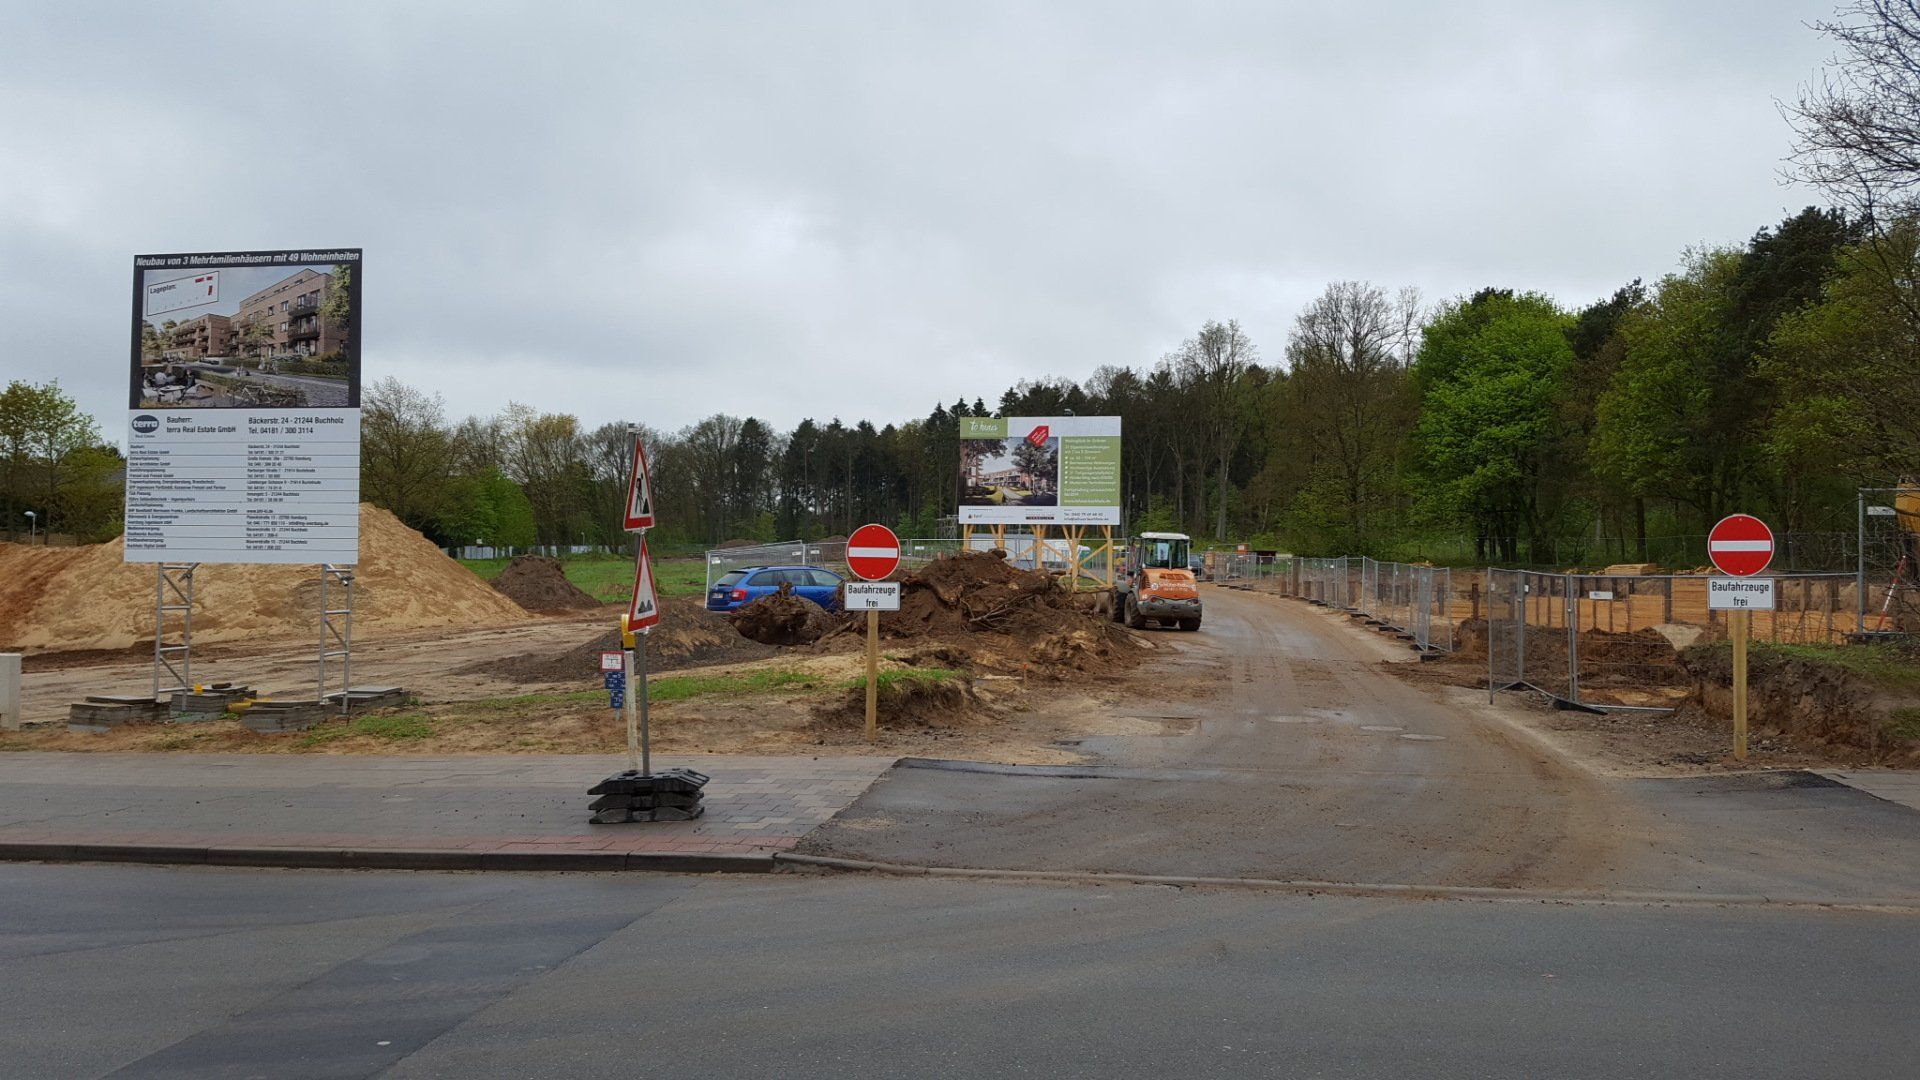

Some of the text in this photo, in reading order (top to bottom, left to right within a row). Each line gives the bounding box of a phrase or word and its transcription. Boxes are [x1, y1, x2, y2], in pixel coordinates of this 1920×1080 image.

[136, 251, 360, 267] Neubau von 3 Mehrfamilienhäusern mit 49 Wohneinheiten
[133, 420, 158, 428] terra
[166, 416, 193, 424] Bauherr:
[248, 416, 280, 424] Bäckerstr.
[280, 416, 289, 424] 24
[293, 416, 313, 424] 21244
[314, 416, 344, 424] Buchholz
[197, 425, 216, 433] Estate
[217, 425, 236, 433] GmbH
[848, 584, 896, 596] Baufahrzeuge
[1711, 581, 1770, 594] Baufahrzeuge
[866, 598, 879, 608] frei
[1733, 596, 1749, 607] frei
